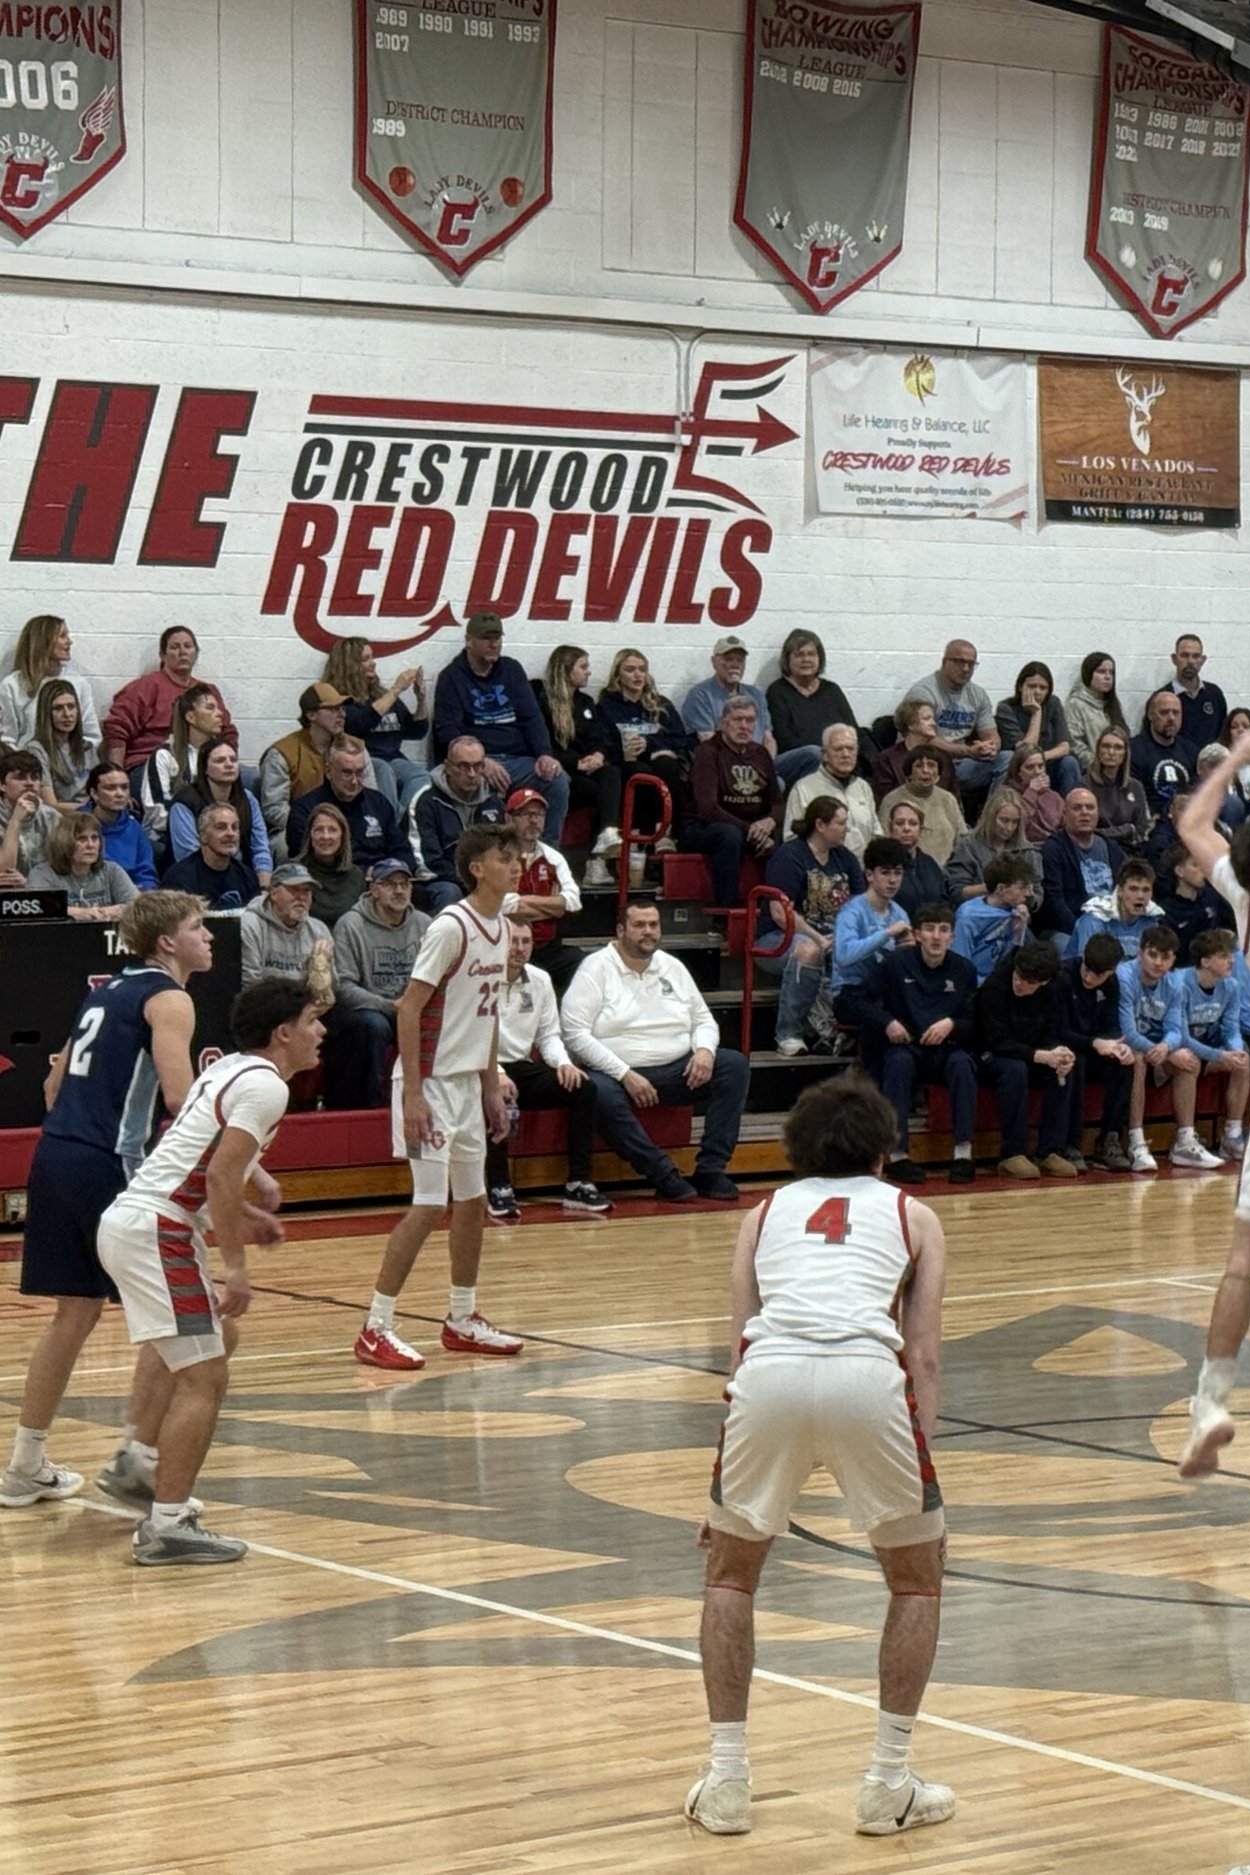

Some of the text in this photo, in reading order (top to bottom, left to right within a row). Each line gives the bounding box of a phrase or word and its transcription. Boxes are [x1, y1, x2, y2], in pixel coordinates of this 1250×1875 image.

[0, 3, 115, 60] MPIONS
[418, 13, 453, 33] 1990
[464, 19, 494, 38] 1991
[774, 0, 894, 40] BOWLING
[375, 32, 409, 52] 2007
[797, 54, 867, 81] LEAGUE
[0, 60, 78, 111] 006
[386, 100, 525, 131] DISTRICT CHAMPION
[1144, 131, 1175, 150] 2017
[424, 175, 496, 216] LADY DEVILS
[842, 414, 862, 429] Life
[865, 414, 909, 433] Hearing
[973, 420, 991, 434] LLC
[290, 437, 669, 514] CRESTWOOD
[822, 450, 1011, 479] CRESTWOOD RED DEVILS
[1081, 455, 1195, 474] LOS VENADOS
[259, 502, 773, 628] RED DEVILS
[2, 899, 44, 915] POSS.
[69, 1006, 105, 1077] 2
[805, 1197, 852, 1245] 4
